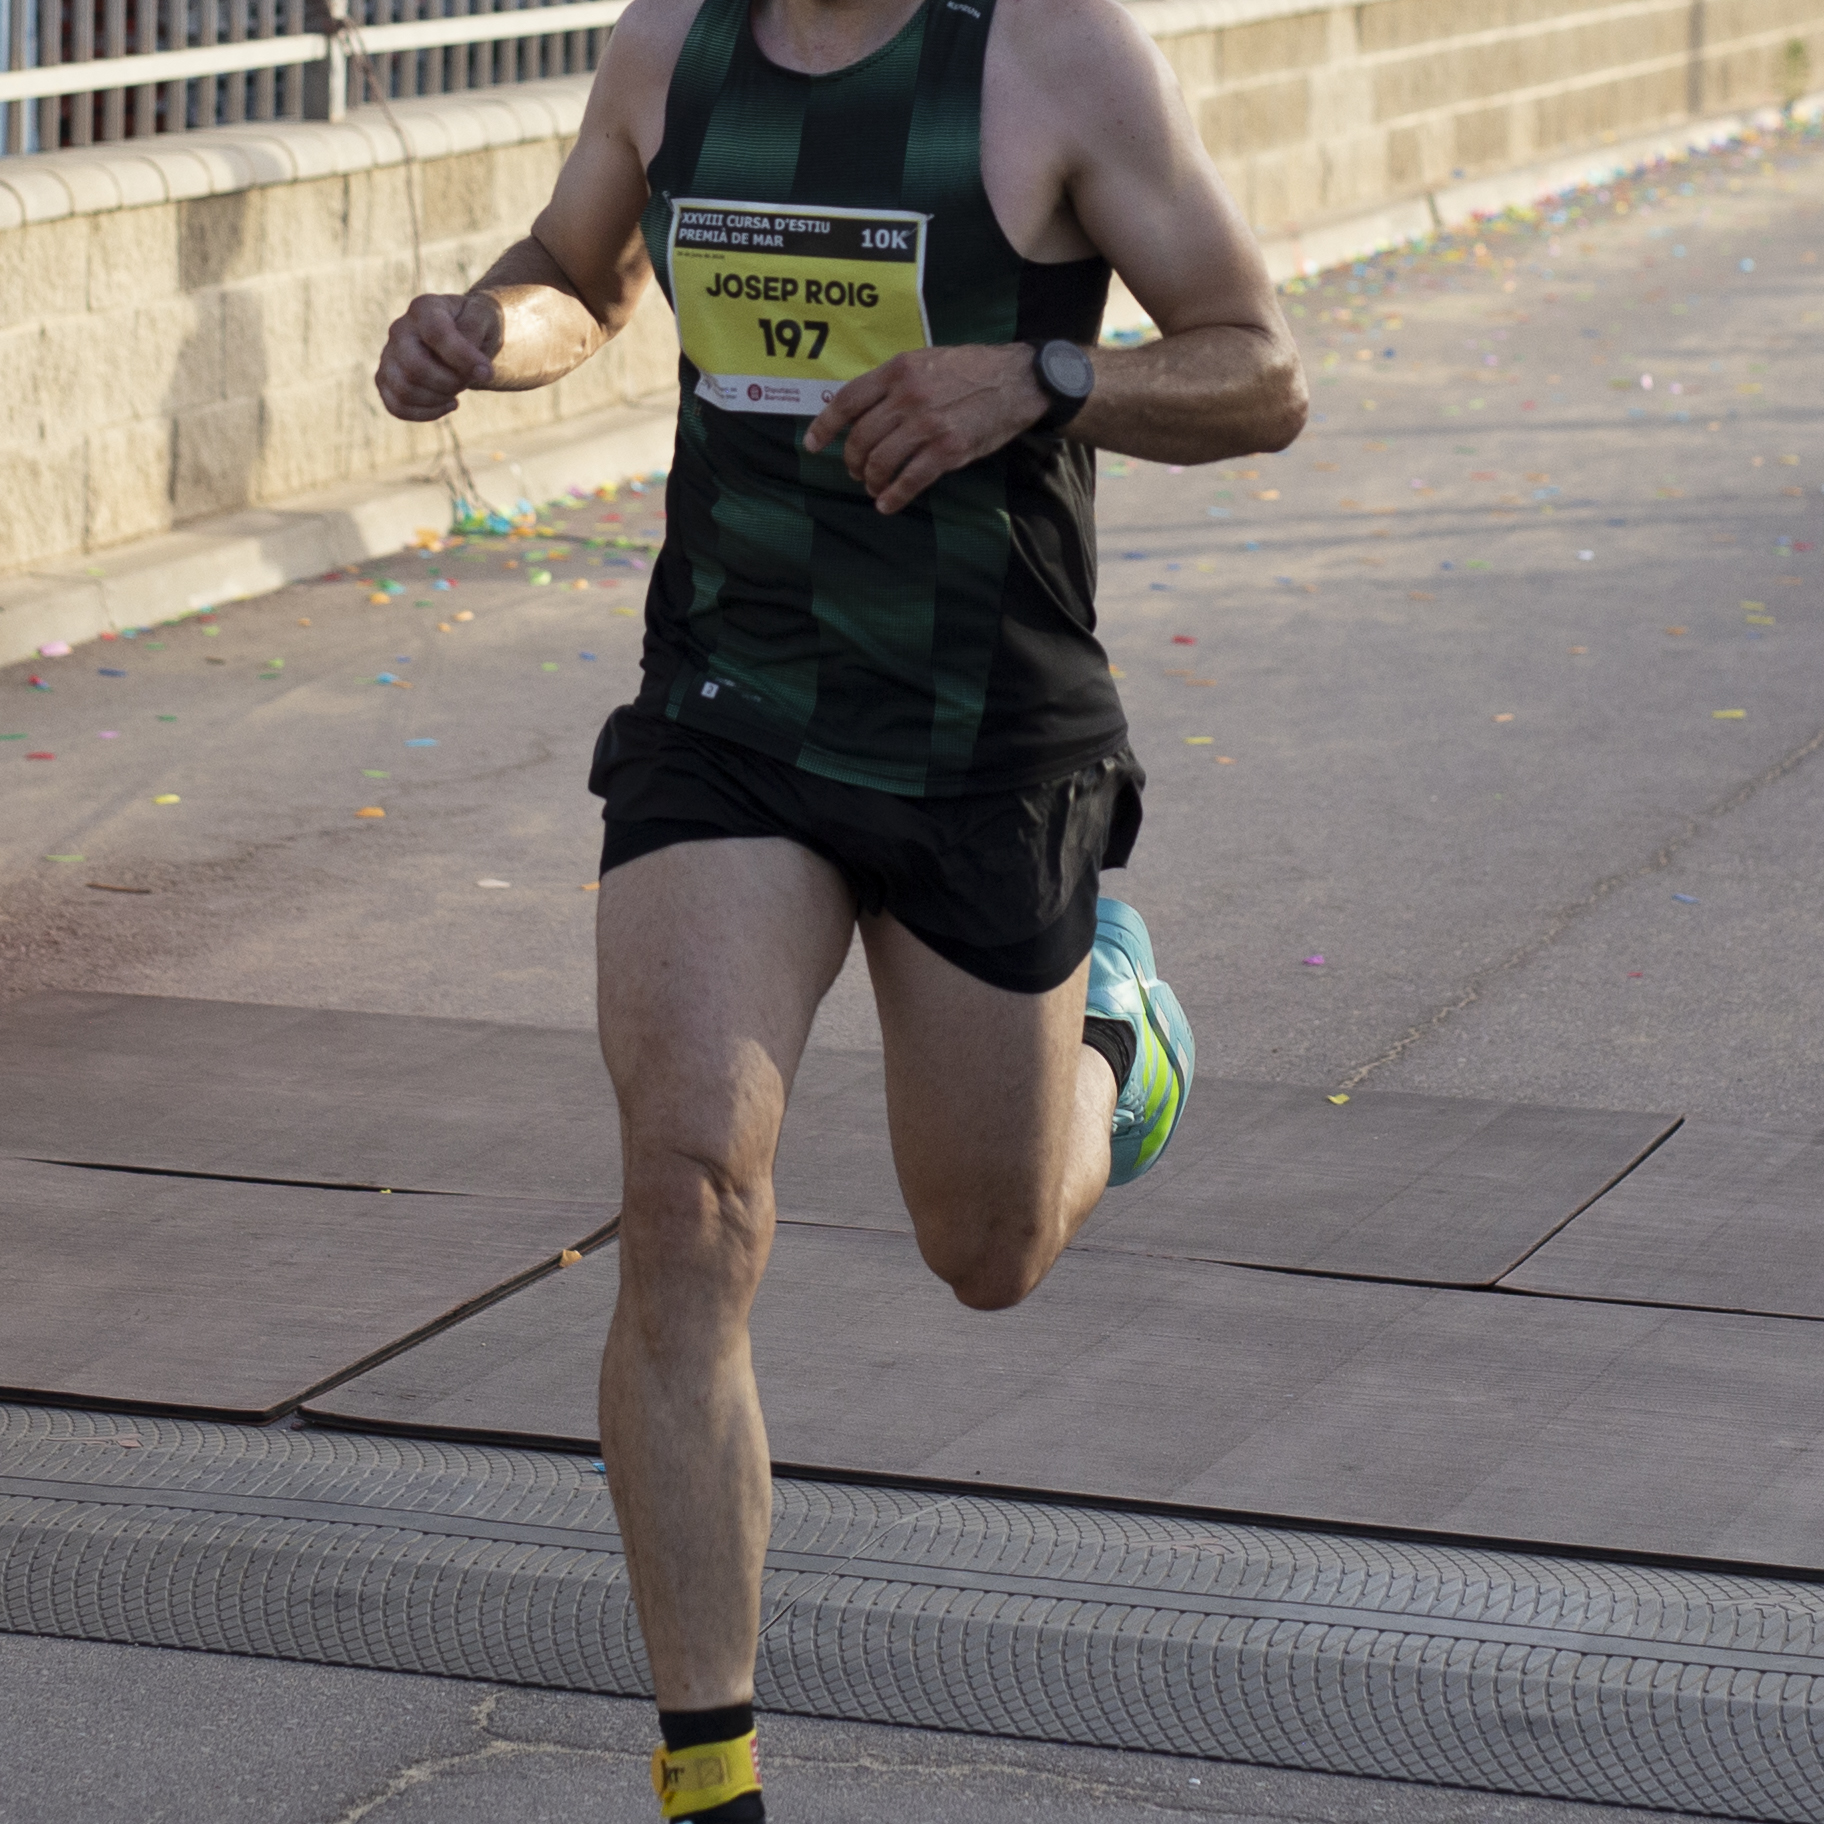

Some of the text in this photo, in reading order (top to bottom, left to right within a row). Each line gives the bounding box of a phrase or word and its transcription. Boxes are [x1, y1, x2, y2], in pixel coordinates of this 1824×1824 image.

[681, 212, 831, 234] XXVIII CURSA D'ESTIU
[678, 227, 784, 247] PREMIÀ DE MAR
[860, 228, 908, 250] 10K
[706, 273, 879, 308] JOSEP ROIG
[758, 318, 830, 360] 197
